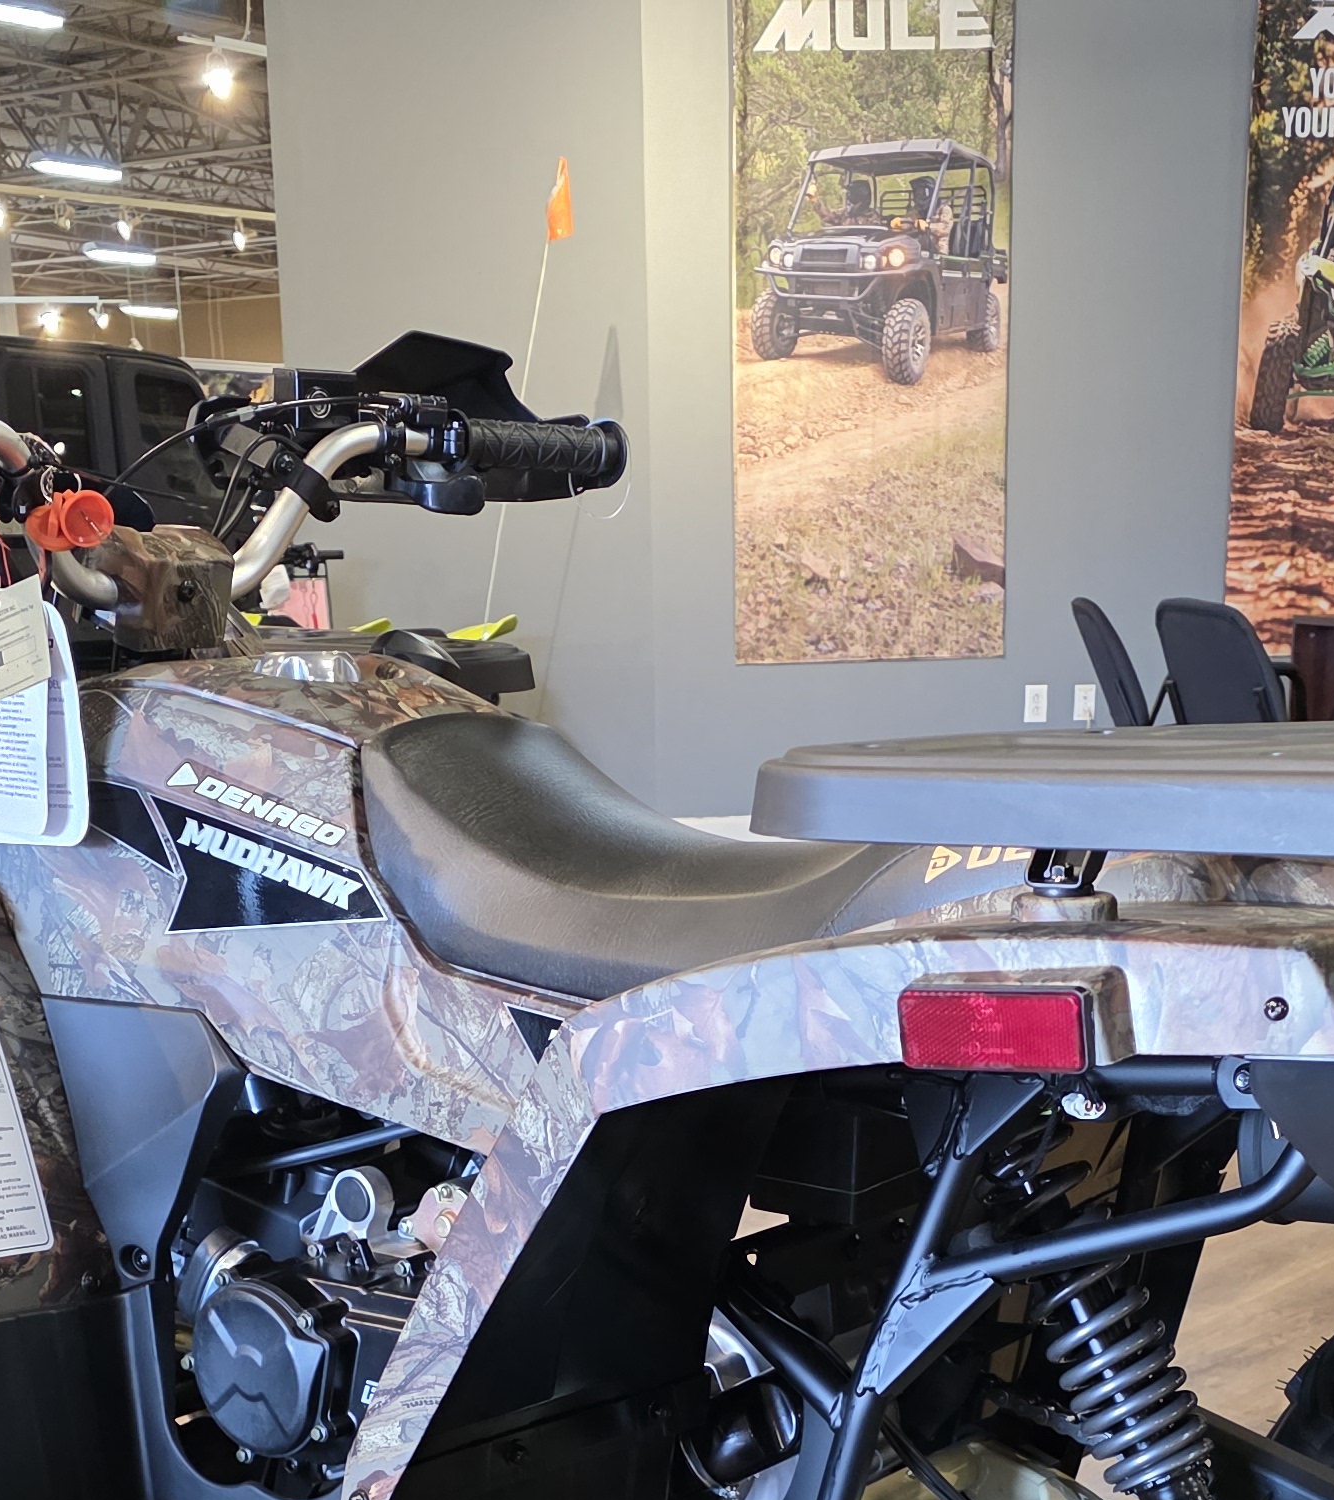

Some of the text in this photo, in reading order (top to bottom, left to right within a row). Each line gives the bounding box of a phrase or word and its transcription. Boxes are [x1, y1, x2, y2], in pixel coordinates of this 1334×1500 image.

[753, 0, 992, 51] MULE
[194, 775, 347, 847] DENAGO
[177, 817, 363, 911] MUDHAWK
